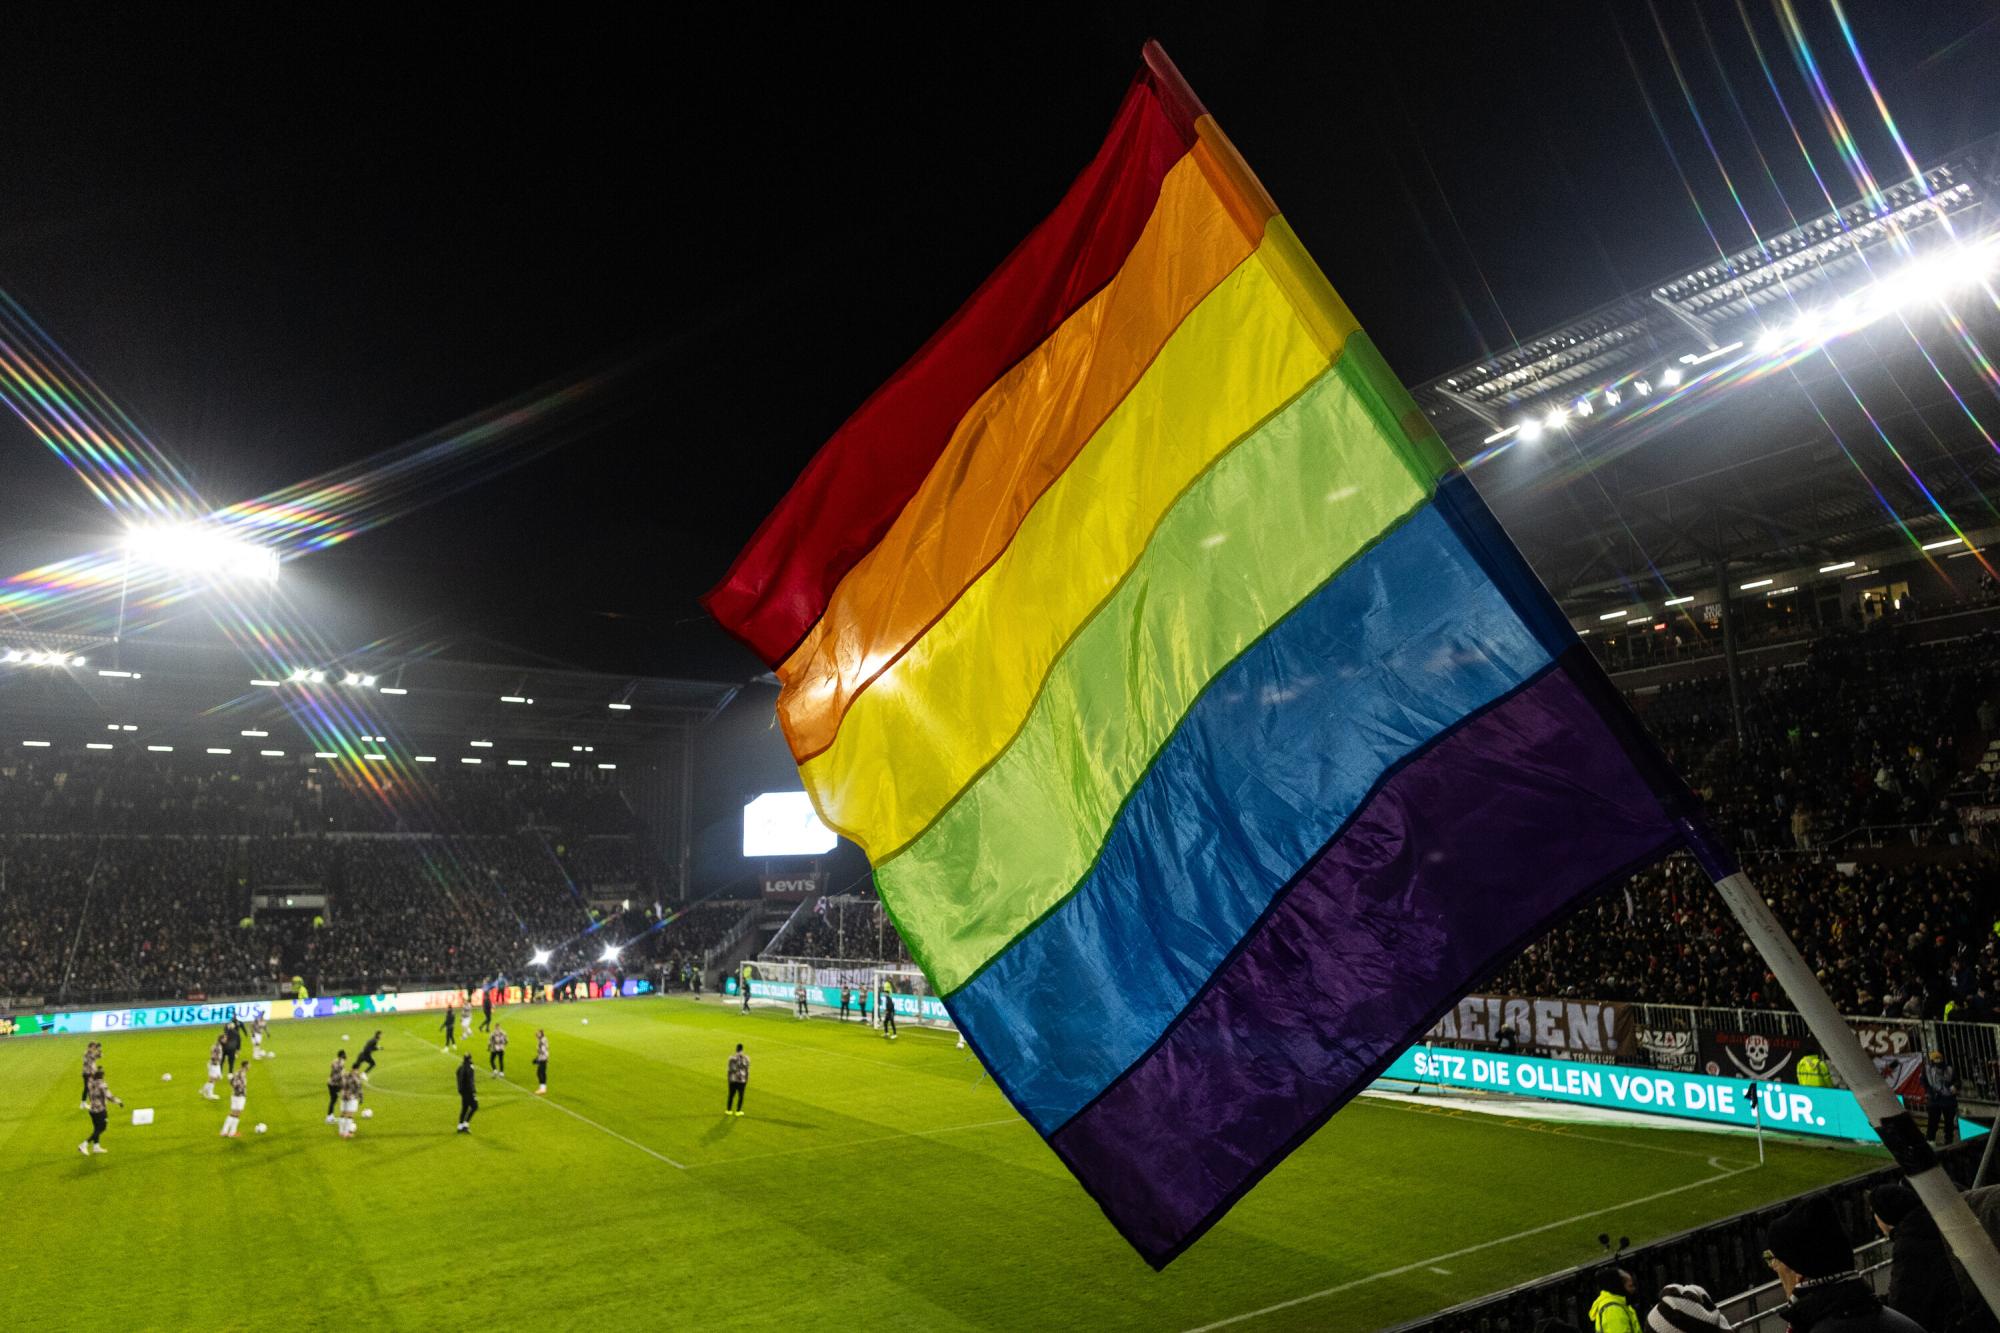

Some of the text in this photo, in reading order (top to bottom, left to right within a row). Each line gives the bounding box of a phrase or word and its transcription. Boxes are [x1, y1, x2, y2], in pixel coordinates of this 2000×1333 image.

[105, 1002, 264, 1028] DER DUSCHBUS
[1414, 1052, 1466, 1080] SETZ
[1472, 1058, 1510, 1086] DIE
[1516, 1063, 1602, 1097] OLLEN
[1609, 1073, 1676, 1107] VOR
[1683, 1082, 1735, 1114] DIE
